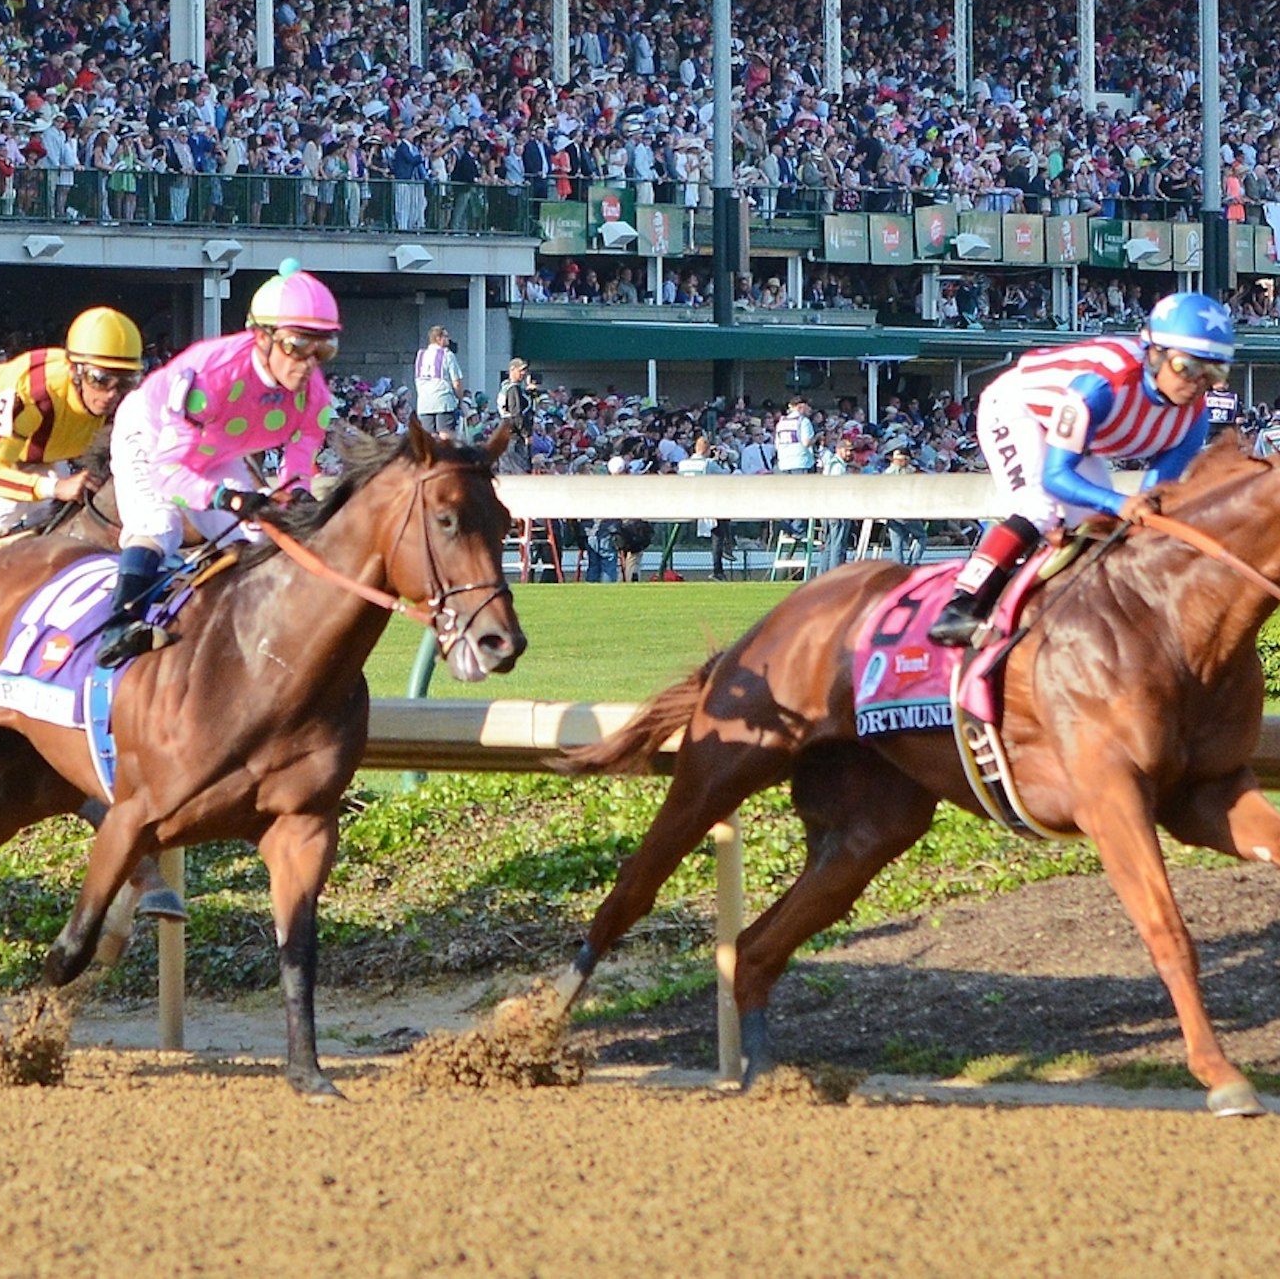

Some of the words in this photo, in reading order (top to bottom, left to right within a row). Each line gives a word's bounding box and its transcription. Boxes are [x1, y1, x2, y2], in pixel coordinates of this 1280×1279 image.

[1056, 404, 1079, 439] 8
[991, 425, 1027, 492] RAM
[894, 652, 931, 676] Yum!
